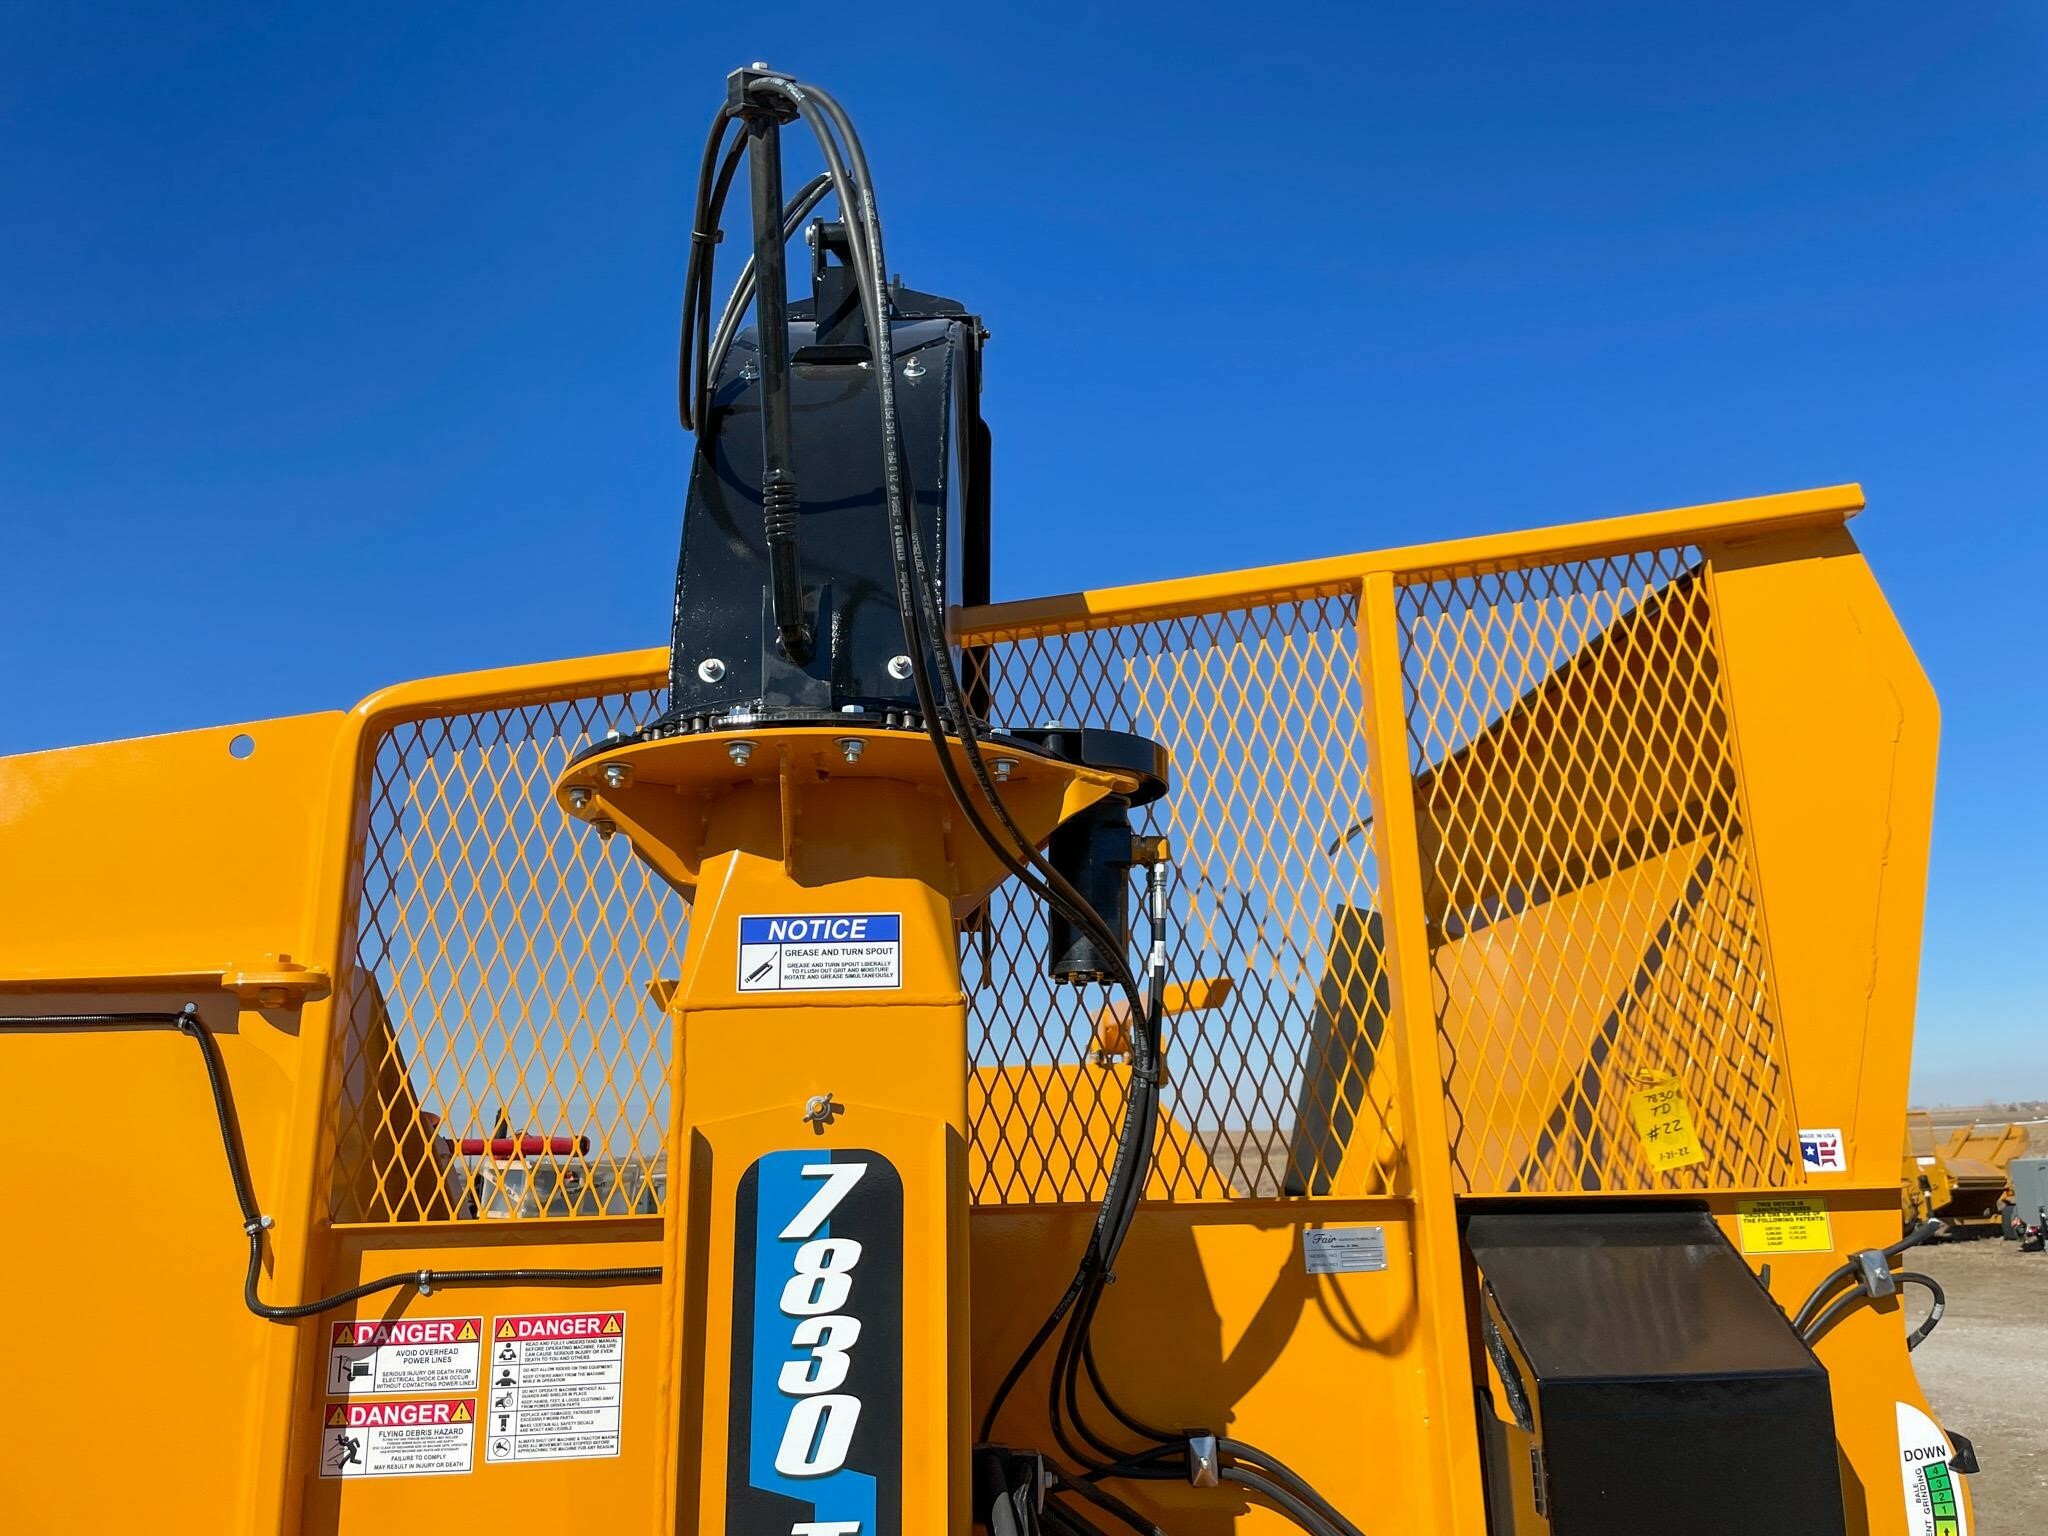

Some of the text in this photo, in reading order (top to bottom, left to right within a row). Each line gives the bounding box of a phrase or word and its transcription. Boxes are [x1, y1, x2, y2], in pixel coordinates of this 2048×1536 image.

[768, 919, 867, 940] NOTICE
[1644, 1091, 1674, 1102] 7830
[1651, 1103, 1670, 1116] TD
[1647, 1119, 1682, 1142] #22
[1660, 1147, 1689, 1160] 1-21-22
[1312, 1234, 1336, 1244] Fair
[519, 1318, 600, 1337] DANGER
[775, 1163, 867, 1477] 7830
[357, 1323, 456, 1345] DANGER
[350, 1404, 450, 1426] DANGER
[1904, 1445, 1946, 1462] DOWN
[1913, 1484, 1921, 1503] BALE
[1915, 1468, 1930, 1514] GRINDING
[1940, 1492, 1944, 1501] 2
